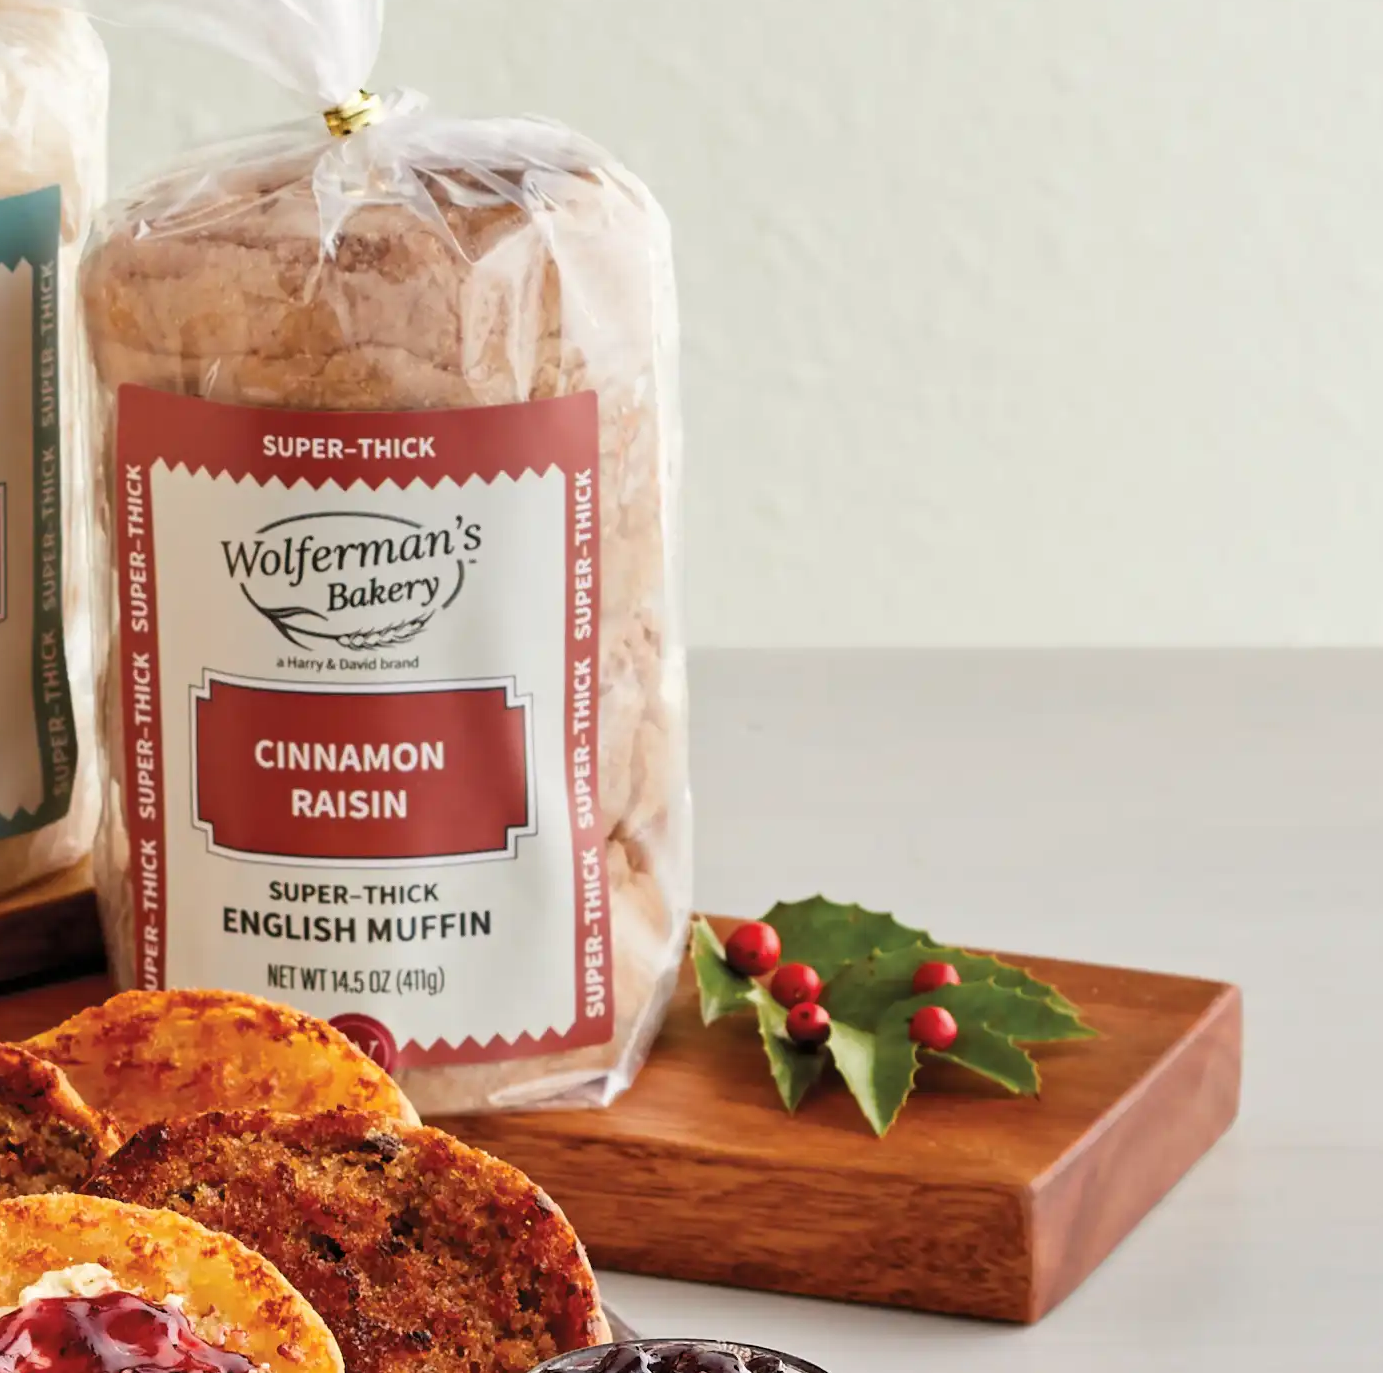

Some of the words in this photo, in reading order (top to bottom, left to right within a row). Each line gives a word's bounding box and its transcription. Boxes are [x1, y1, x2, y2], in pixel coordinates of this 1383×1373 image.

[38, 259, 57, 427] SUPER-THICK
[262, 434, 437, 461] SUPER-THICK
[40, 443, 59, 611] SUPER-THICK
[126, 463, 149, 634] SUPER-THICK
[220, 515, 482, 587] Wolferman's
[574, 468, 592, 641] SUPER-THICK
[327, 577, 440, 612] Bakery
[41, 630, 69, 799] SUPER-THICK
[276, 659, 285, 669] a
[288, 656, 323, 672] Harry
[326, 658, 336, 670] &
[339, 658, 377, 670] David
[380, 656, 419, 670] brand
[133, 651, 157, 821] SUPER-THICK
[254, 739, 445, 772] CINNAMON
[573, 657, 593, 830] SUPER-THICK
[291, 789, 408, 819] RAISIN
[140, 838, 159, 992] UPER-THICK
[223, 907, 356, 943] ENGLISH
[367, 910, 491, 943] MUFFIN
[268, 880, 440, 904] SUPER-THICK
[585, 847, 606, 1017] SUPER-THICK
[267, 963, 296, 989] NET
[301, 966, 328, 992] WT
[331, 970, 365, 995] 14.5
[369, 971, 391, 993] OZ
[396, 966, 445, 996] (411g)
